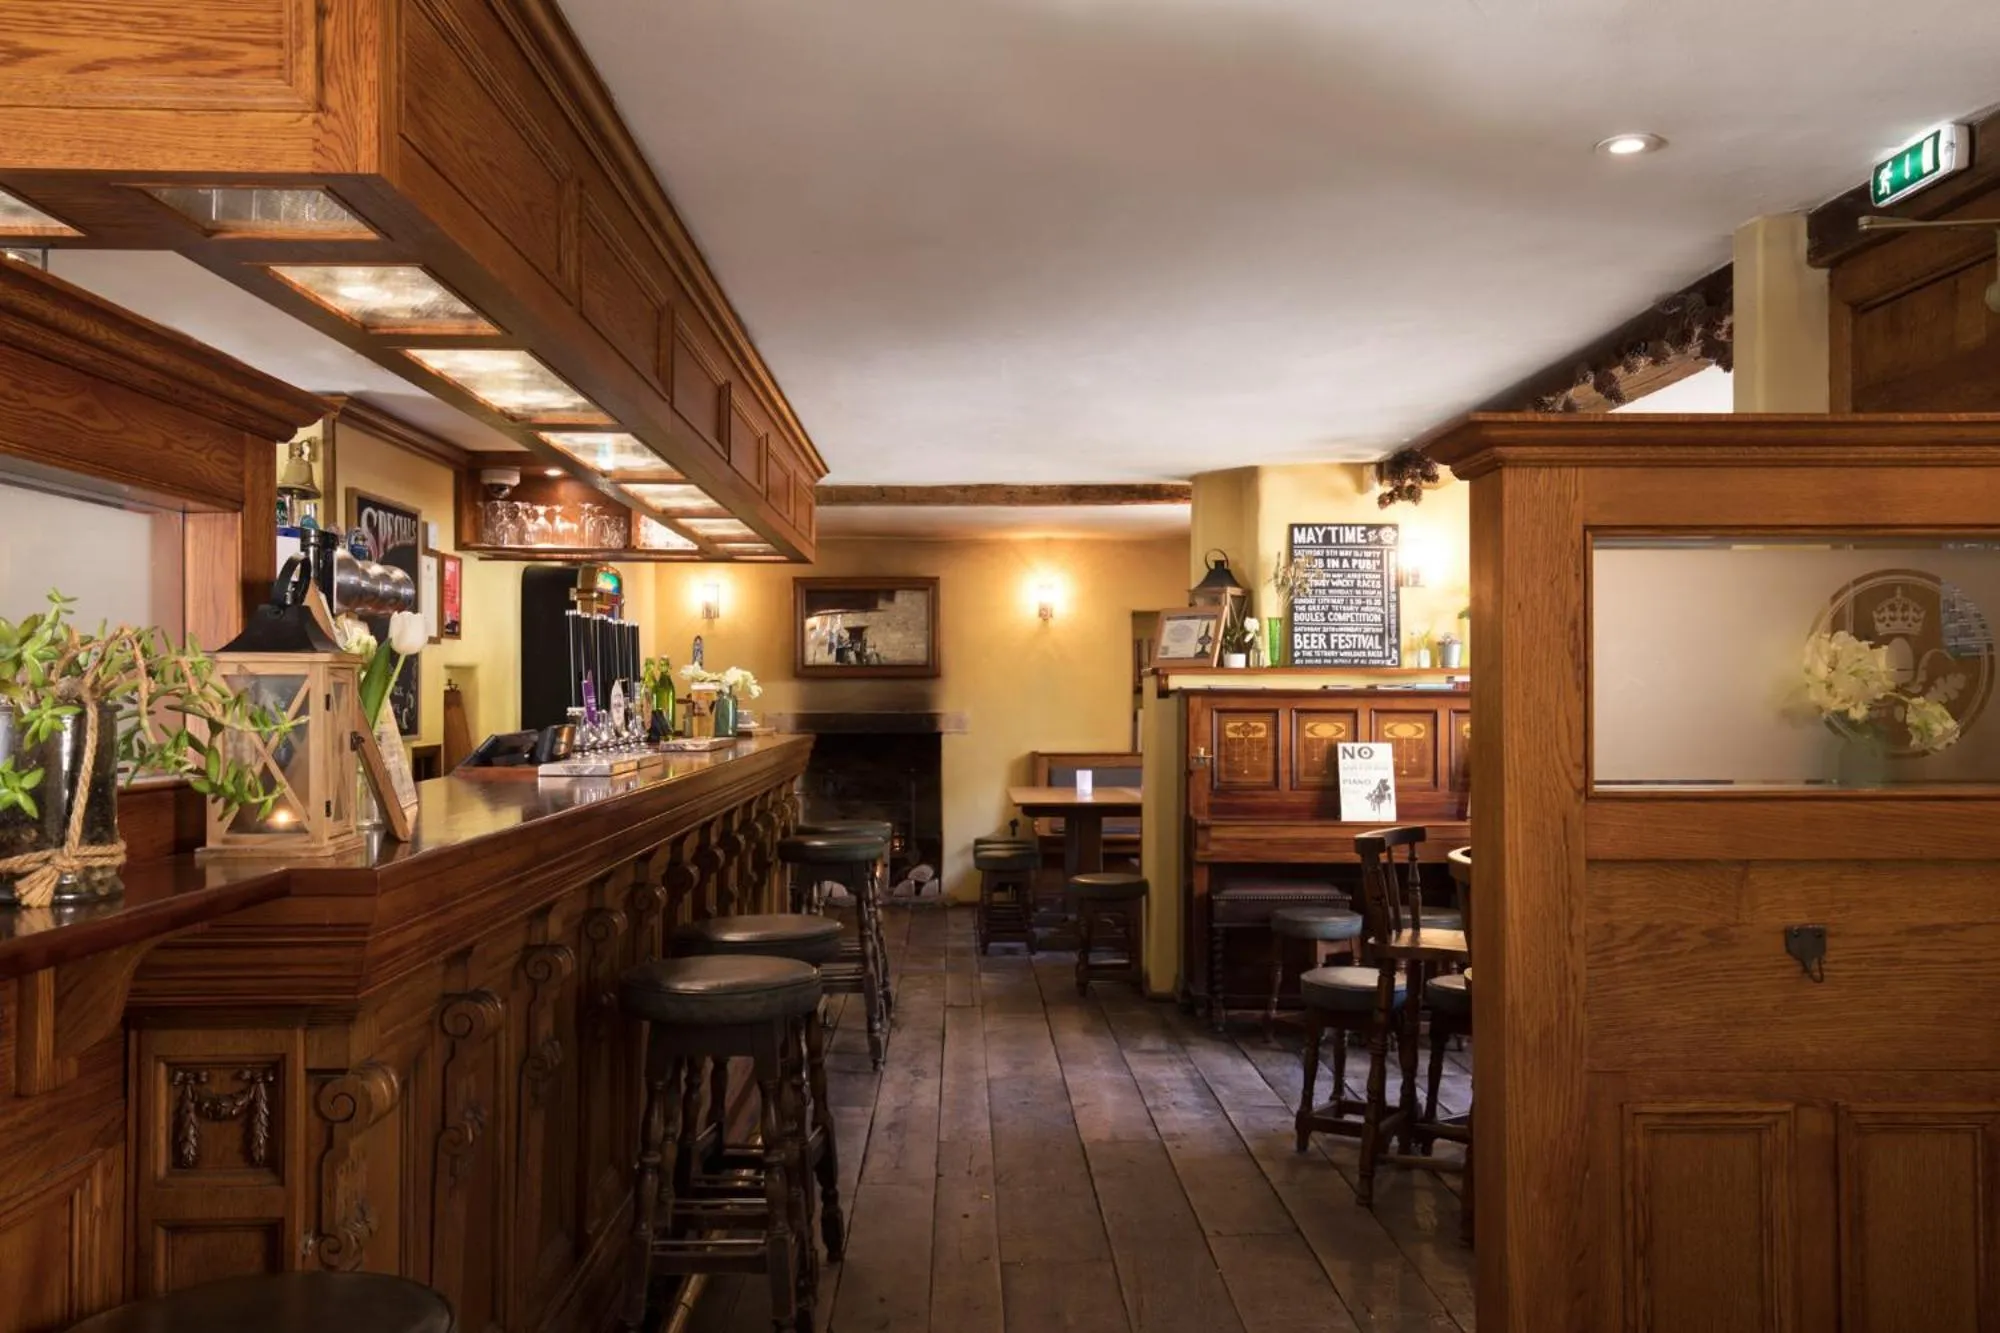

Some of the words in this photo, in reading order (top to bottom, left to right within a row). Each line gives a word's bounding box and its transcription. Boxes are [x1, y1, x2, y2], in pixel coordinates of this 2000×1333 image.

[1326, 558, 1340, 568] IN
[1342, 559, 1350, 568] A
[1294, 612, 1325, 622] BOULES
[1327, 612, 1382, 623] COMPETITION
[1294, 633, 1327, 649] BEER
[1330, 633, 1382, 649] FESTIVAL
[1342, 746, 1375, 760] NO
